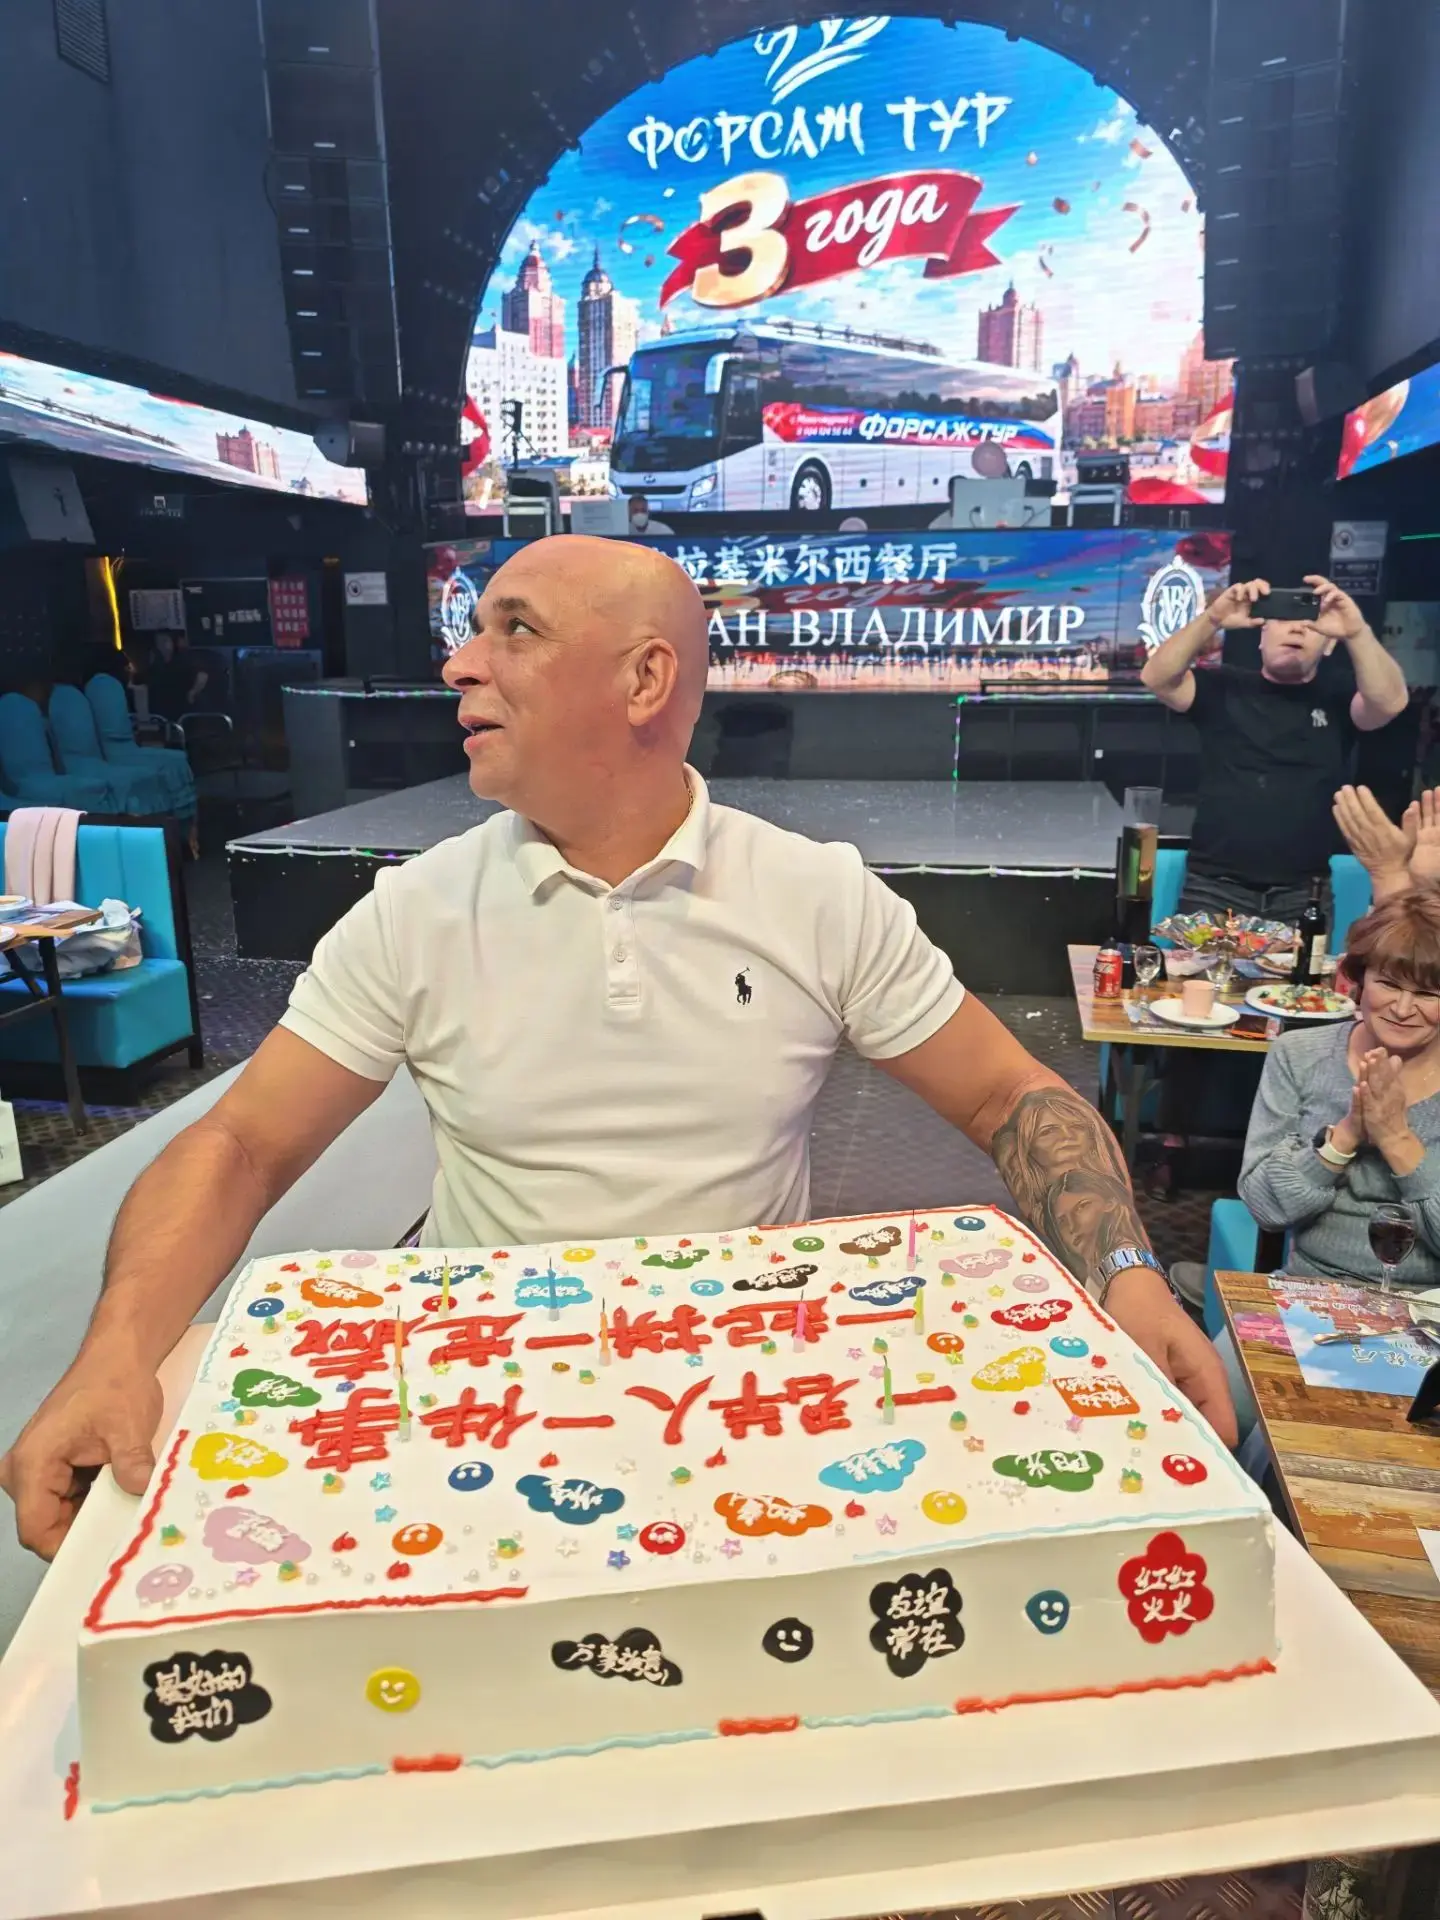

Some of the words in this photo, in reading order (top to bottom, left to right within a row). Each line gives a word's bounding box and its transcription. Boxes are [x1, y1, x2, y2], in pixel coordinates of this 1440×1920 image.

[628, 102, 866, 169] ФОРСАЖ
[887, 91, 1014, 152] ТУР
[690, 171, 791, 309] 3
[805, 184, 948, 269] года
[652, 542, 958, 585] 拉基米尔西餐厅
[790, 604, 1087, 652] ВЛАДИМИР
[1134, 1565, 1198, 1595] 红红
[1142, 1591, 1197, 1624] 火火
